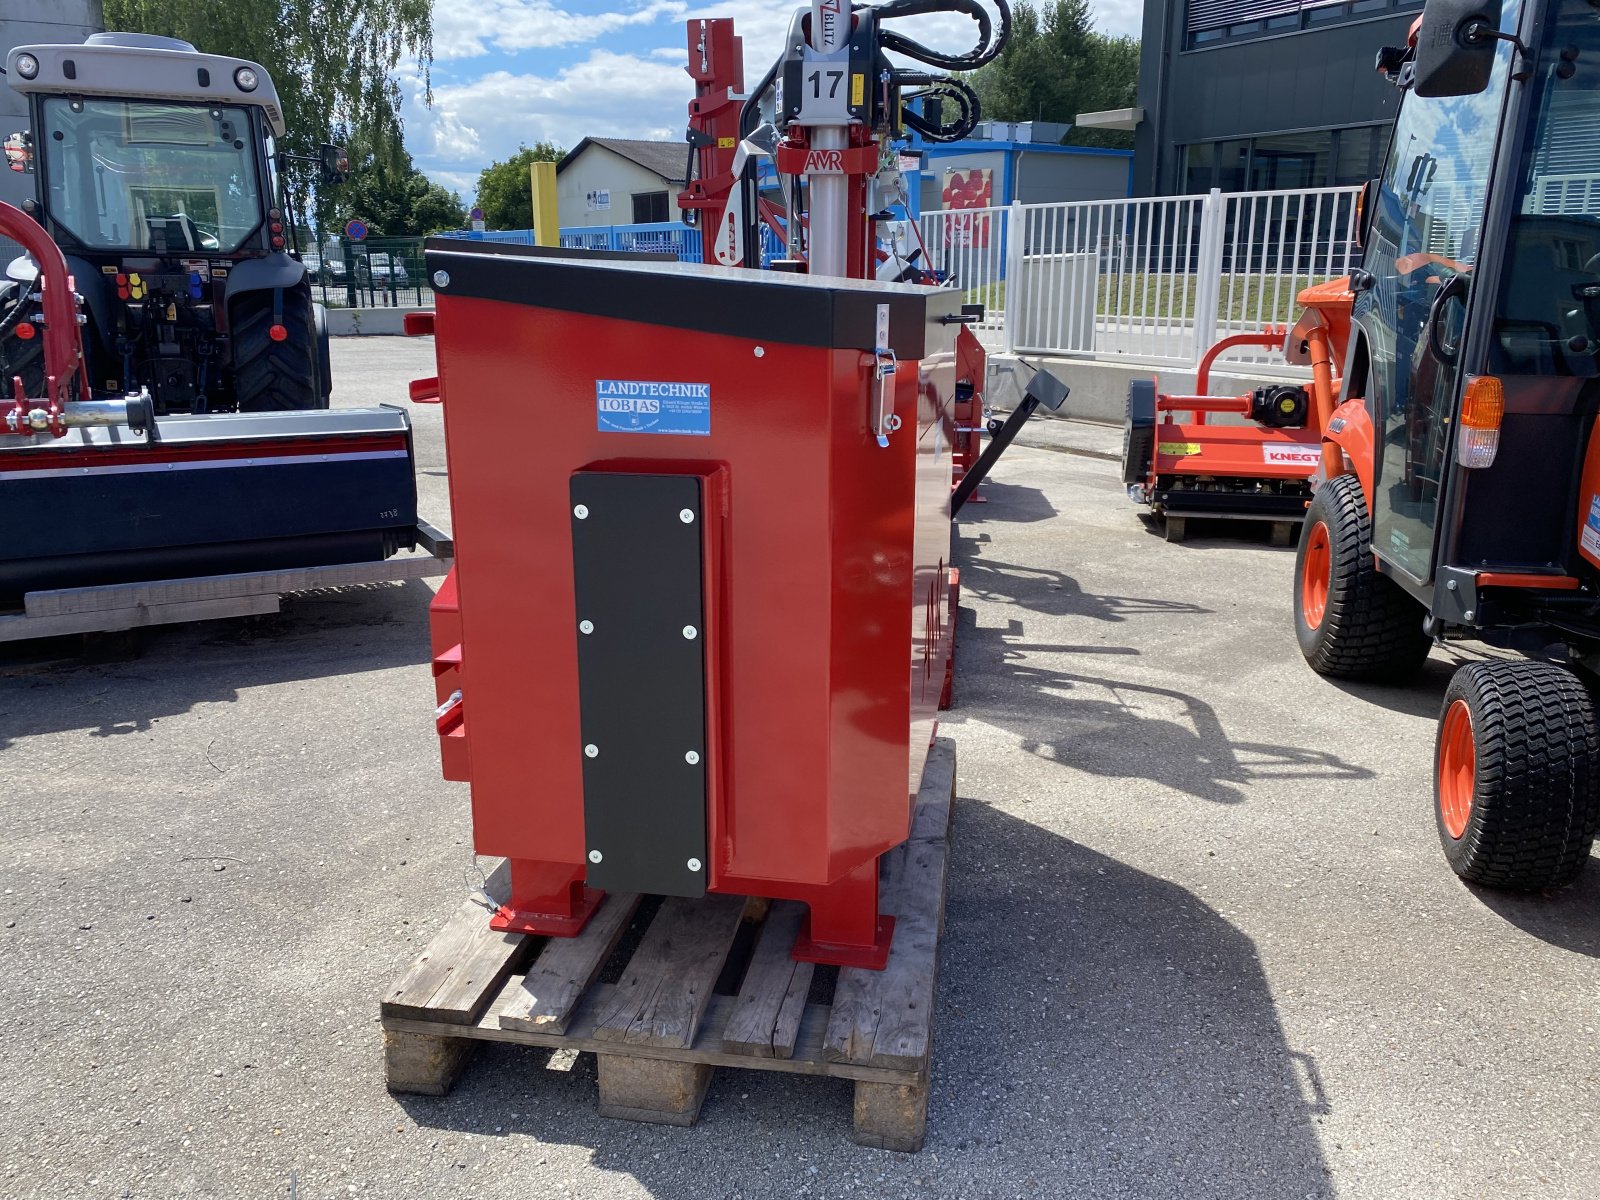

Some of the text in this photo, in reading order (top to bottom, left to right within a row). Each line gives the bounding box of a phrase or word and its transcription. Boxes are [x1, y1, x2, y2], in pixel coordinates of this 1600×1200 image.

[824, 13, 835, 46] BLITZ
[808, 70, 844, 99] 17
[804, 151, 842, 171] AMR
[598, 381, 708, 398] LANDTECHNIK
[600, 398, 659, 413] TOBIAS
[1270, 452, 1321, 462] KNEGT
